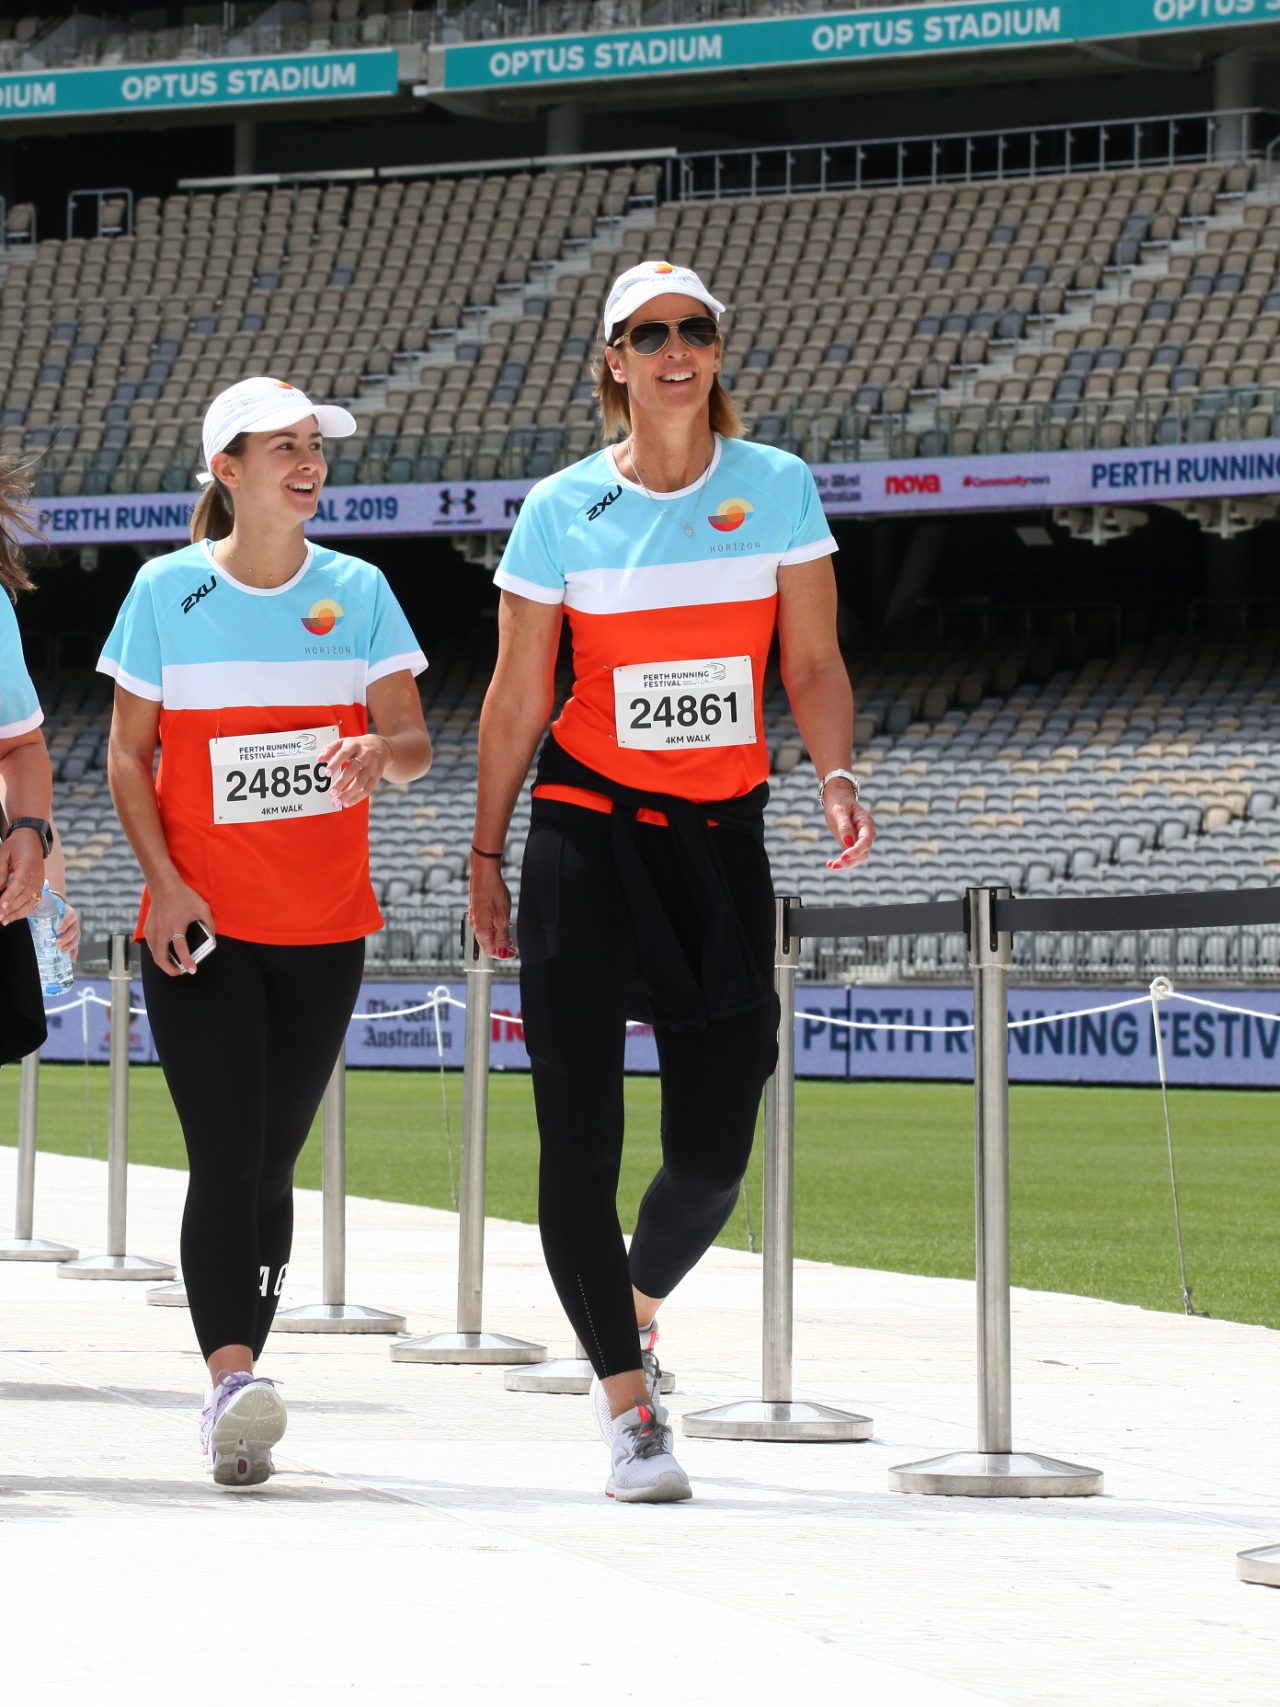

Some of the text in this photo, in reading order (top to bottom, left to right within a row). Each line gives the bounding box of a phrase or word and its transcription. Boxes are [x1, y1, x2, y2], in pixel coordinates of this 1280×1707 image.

[812, 6, 1061, 53] OPTUS STADIUM
[489, 36, 723, 78] OPTUS STADIUM
[121, 62, 357, 101] OPTUS STADIUM
[1091, 452, 1280, 489] PERTH RUNNIN
[884, 473, 941, 495] nova
[344, 496, 399, 522] 2019
[585, 484, 623, 522] 2XU
[39, 504, 196, 532] PERTH RUNNI
[708, 541, 762, 553] HORIZON
[180, 575, 217, 614] 2XU
[304, 646, 352, 655] HORIZON
[642, 670, 710, 681] PERTH RUNNING
[643, 680, 681, 688] FESTIVAL
[629, 691, 738, 729] 24861
[239, 745, 265, 754] PERTH
[266, 741, 302, 751] RUNNING
[665, 734, 711, 744] 4KM WALK
[239, 751, 276, 761] FESTIVAL
[226, 761, 332, 802] 24859
[261, 804, 304, 816] 4KM WALK
[363, 1025, 453, 1049] Australian
[803, 1006, 933, 1052] PERTH
[944, 1009, 1139, 1057] RNNING
